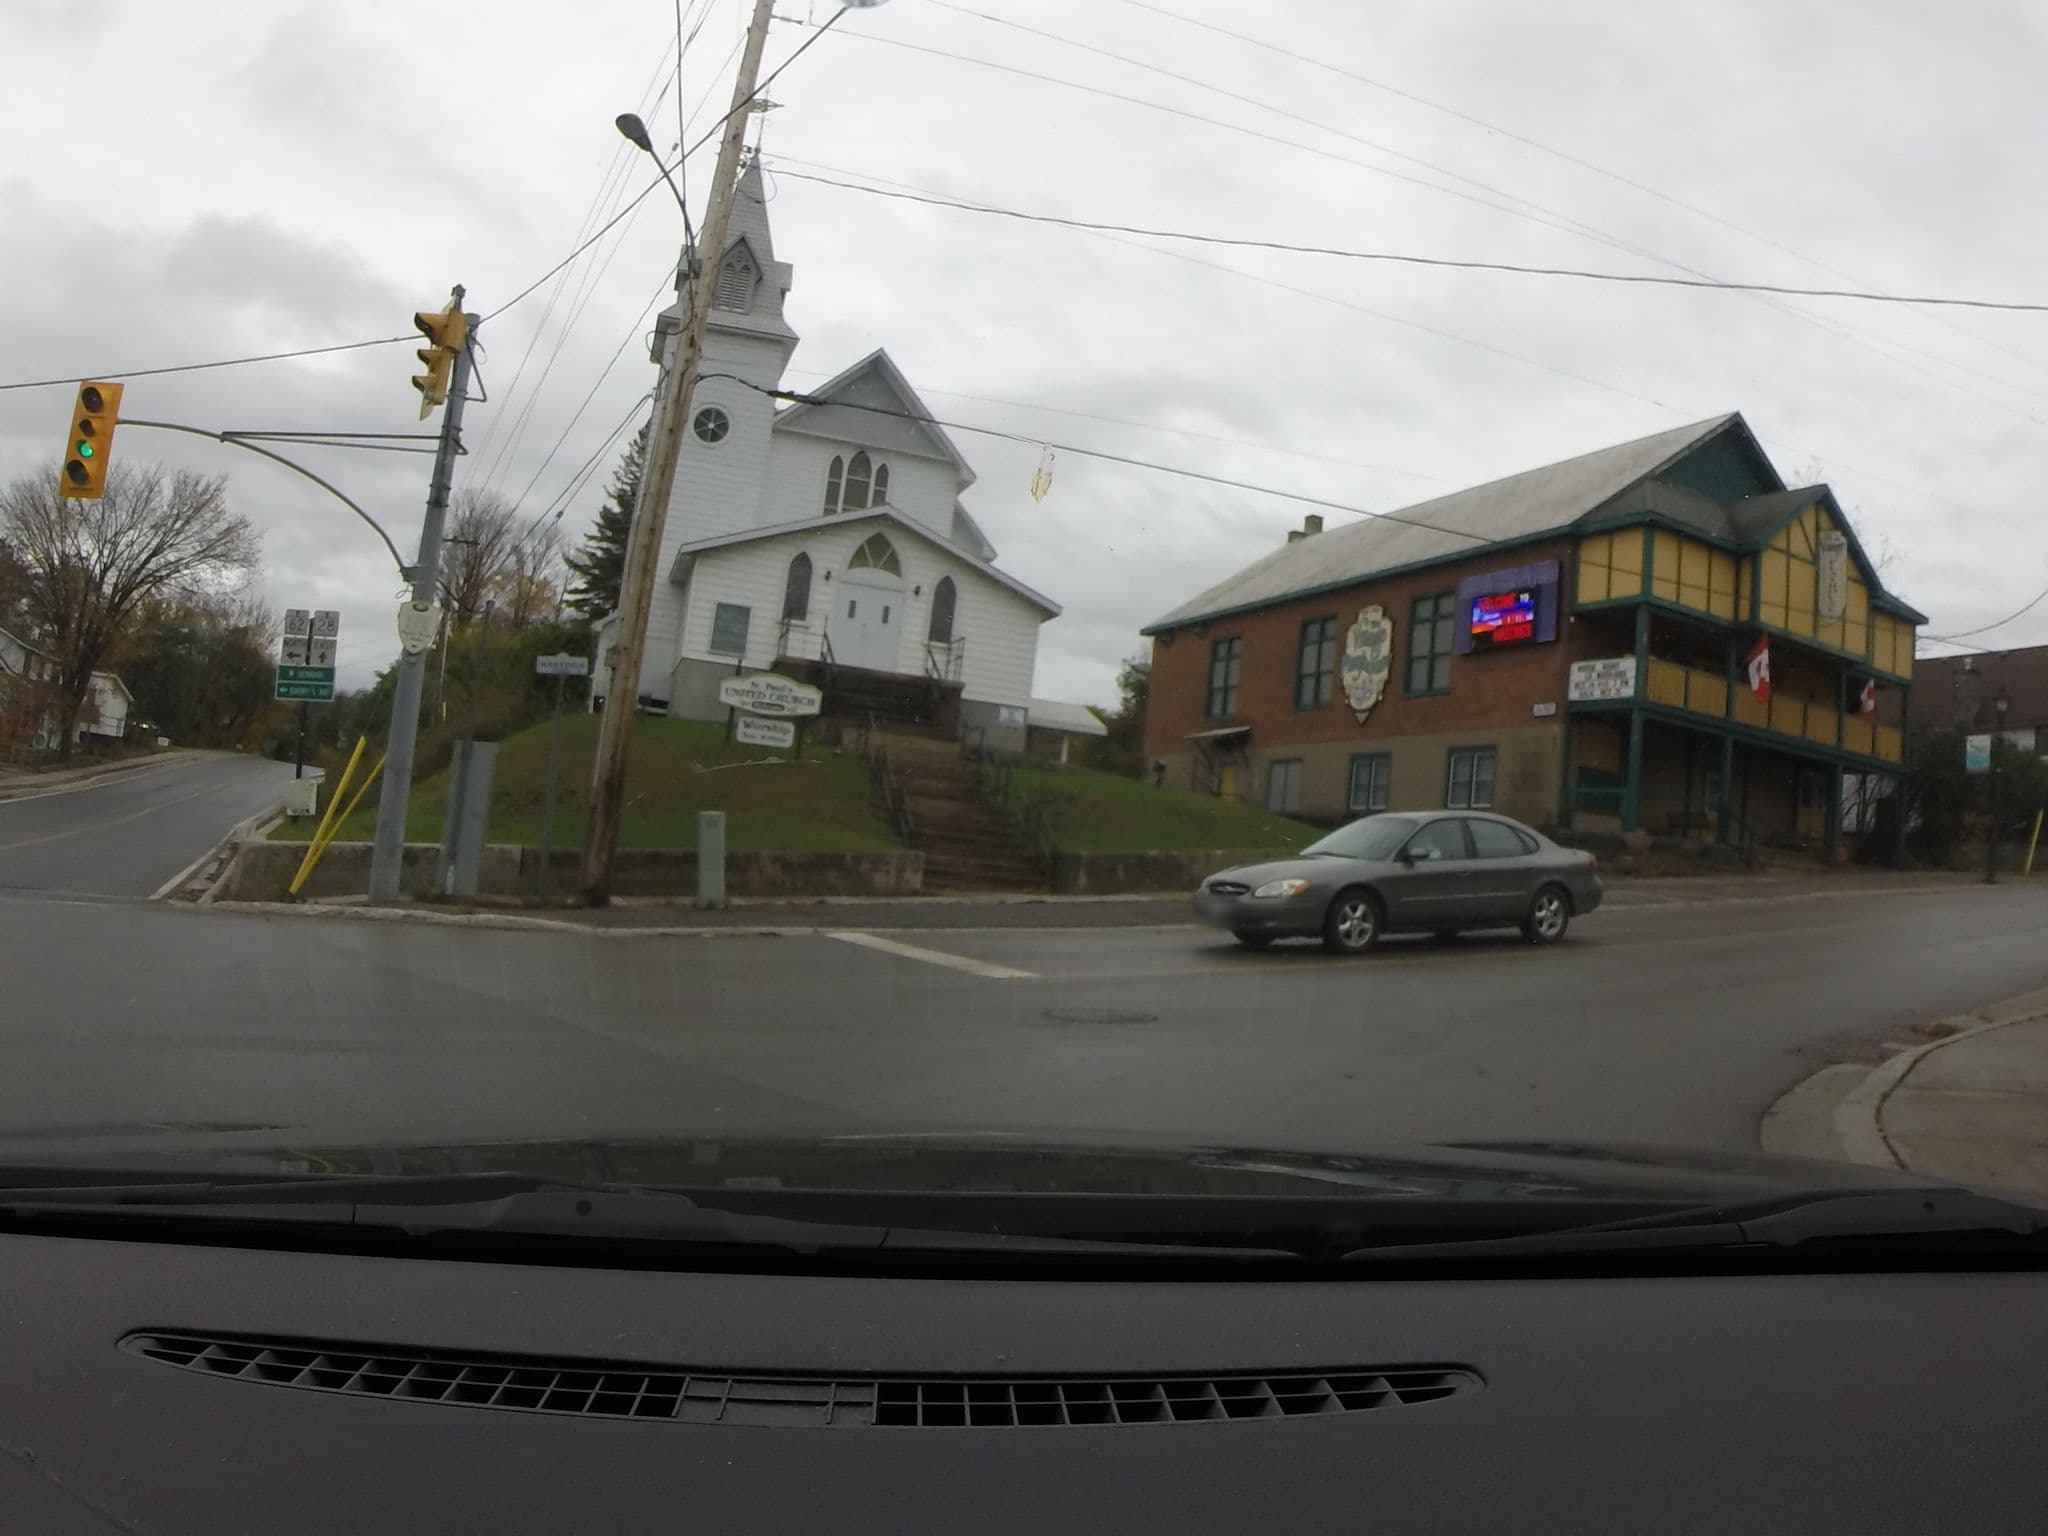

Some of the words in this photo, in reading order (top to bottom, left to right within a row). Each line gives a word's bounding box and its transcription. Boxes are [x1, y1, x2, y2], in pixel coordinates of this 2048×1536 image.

[288, 617, 305, 632] 62
[317, 620, 335, 633] 28
[725, 687, 766, 700] UNITED
[768, 693, 815, 707] CHURCH
[743, 719, 791, 736] Worship
